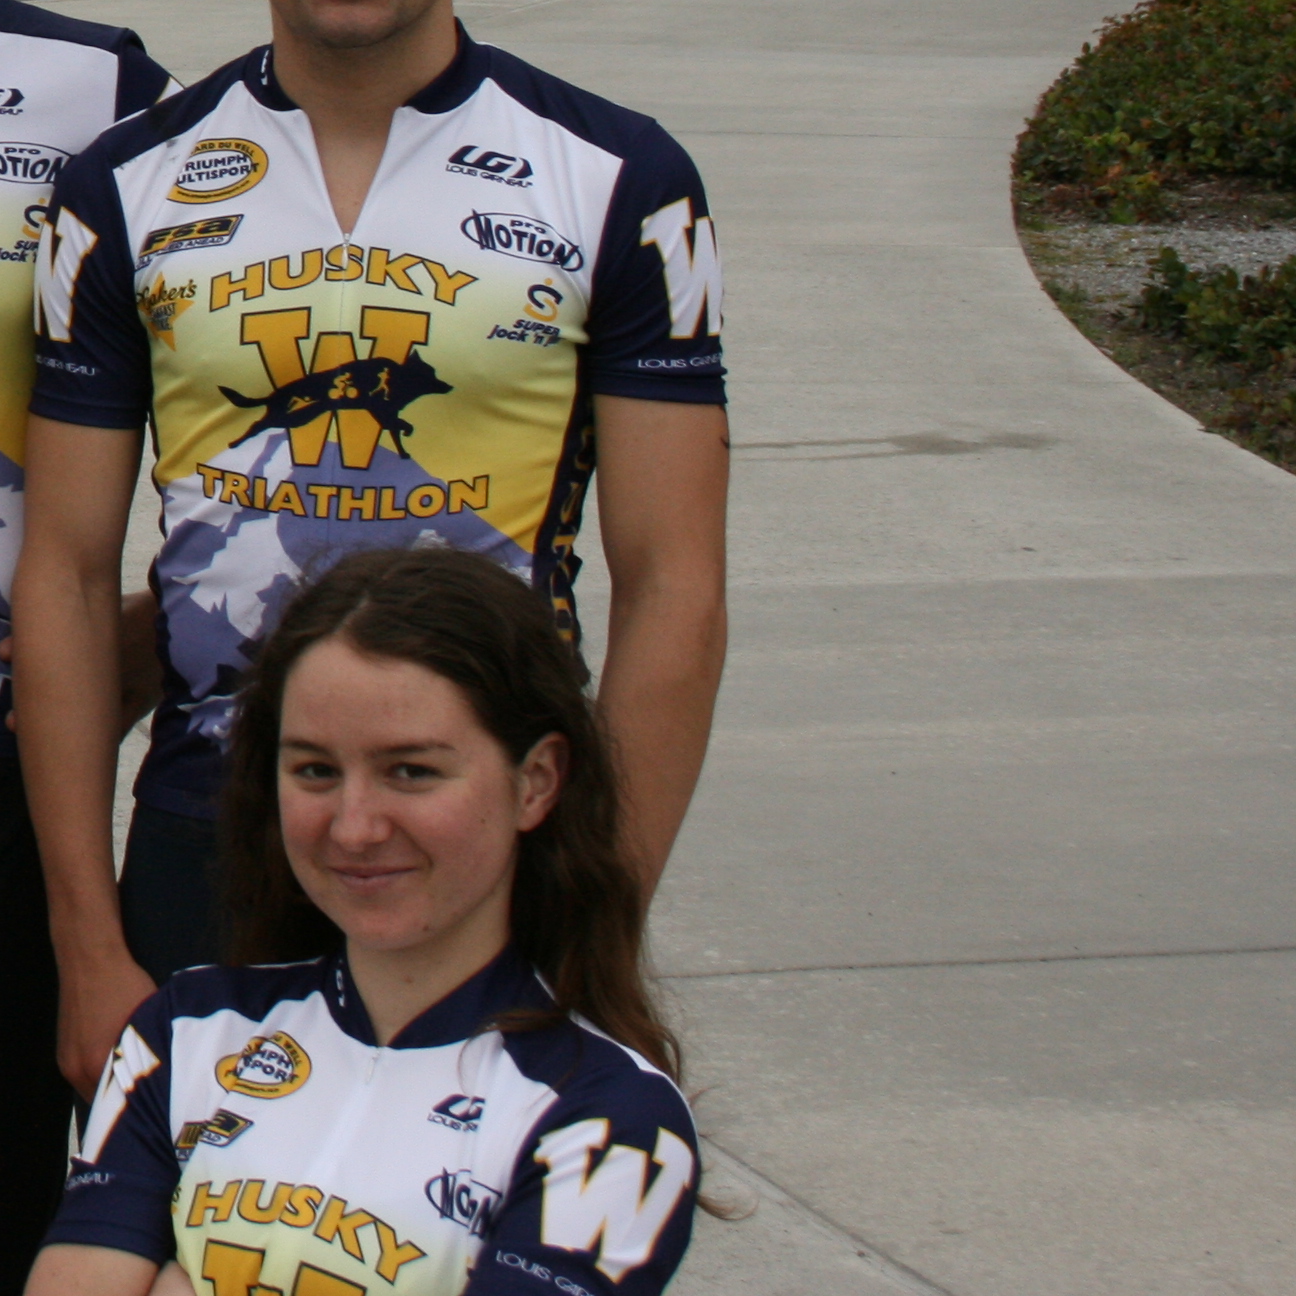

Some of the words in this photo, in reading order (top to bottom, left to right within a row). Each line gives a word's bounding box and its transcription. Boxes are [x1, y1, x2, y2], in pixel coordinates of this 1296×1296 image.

[4, 146, 41, 154] pro
[194, 142, 215, 151] ARD
[234, 142, 254, 157] WELL
[183, 155, 248, 171] RIUMPH
[445, 163, 478, 177] LOUIS
[176, 163, 259, 184] ULTISPORT
[510, 219, 547, 235] pro
[186, 236, 224, 247] AHEAD
[472, 208, 580, 269] MOTION
[209, 243, 479, 313] HUSKY
[513, 319, 560, 336] SUPER
[637, 358, 687, 369] LOUIS
[240, 305, 431, 470] W
[196, 463, 490, 522] TRIATHLON
[427, 1113, 462, 1131] LOUIS
[534, 1117, 694, 1286] W
[186, 1179, 428, 1285] HUSKY
[496, 1250, 551, 1281] LOUIS
